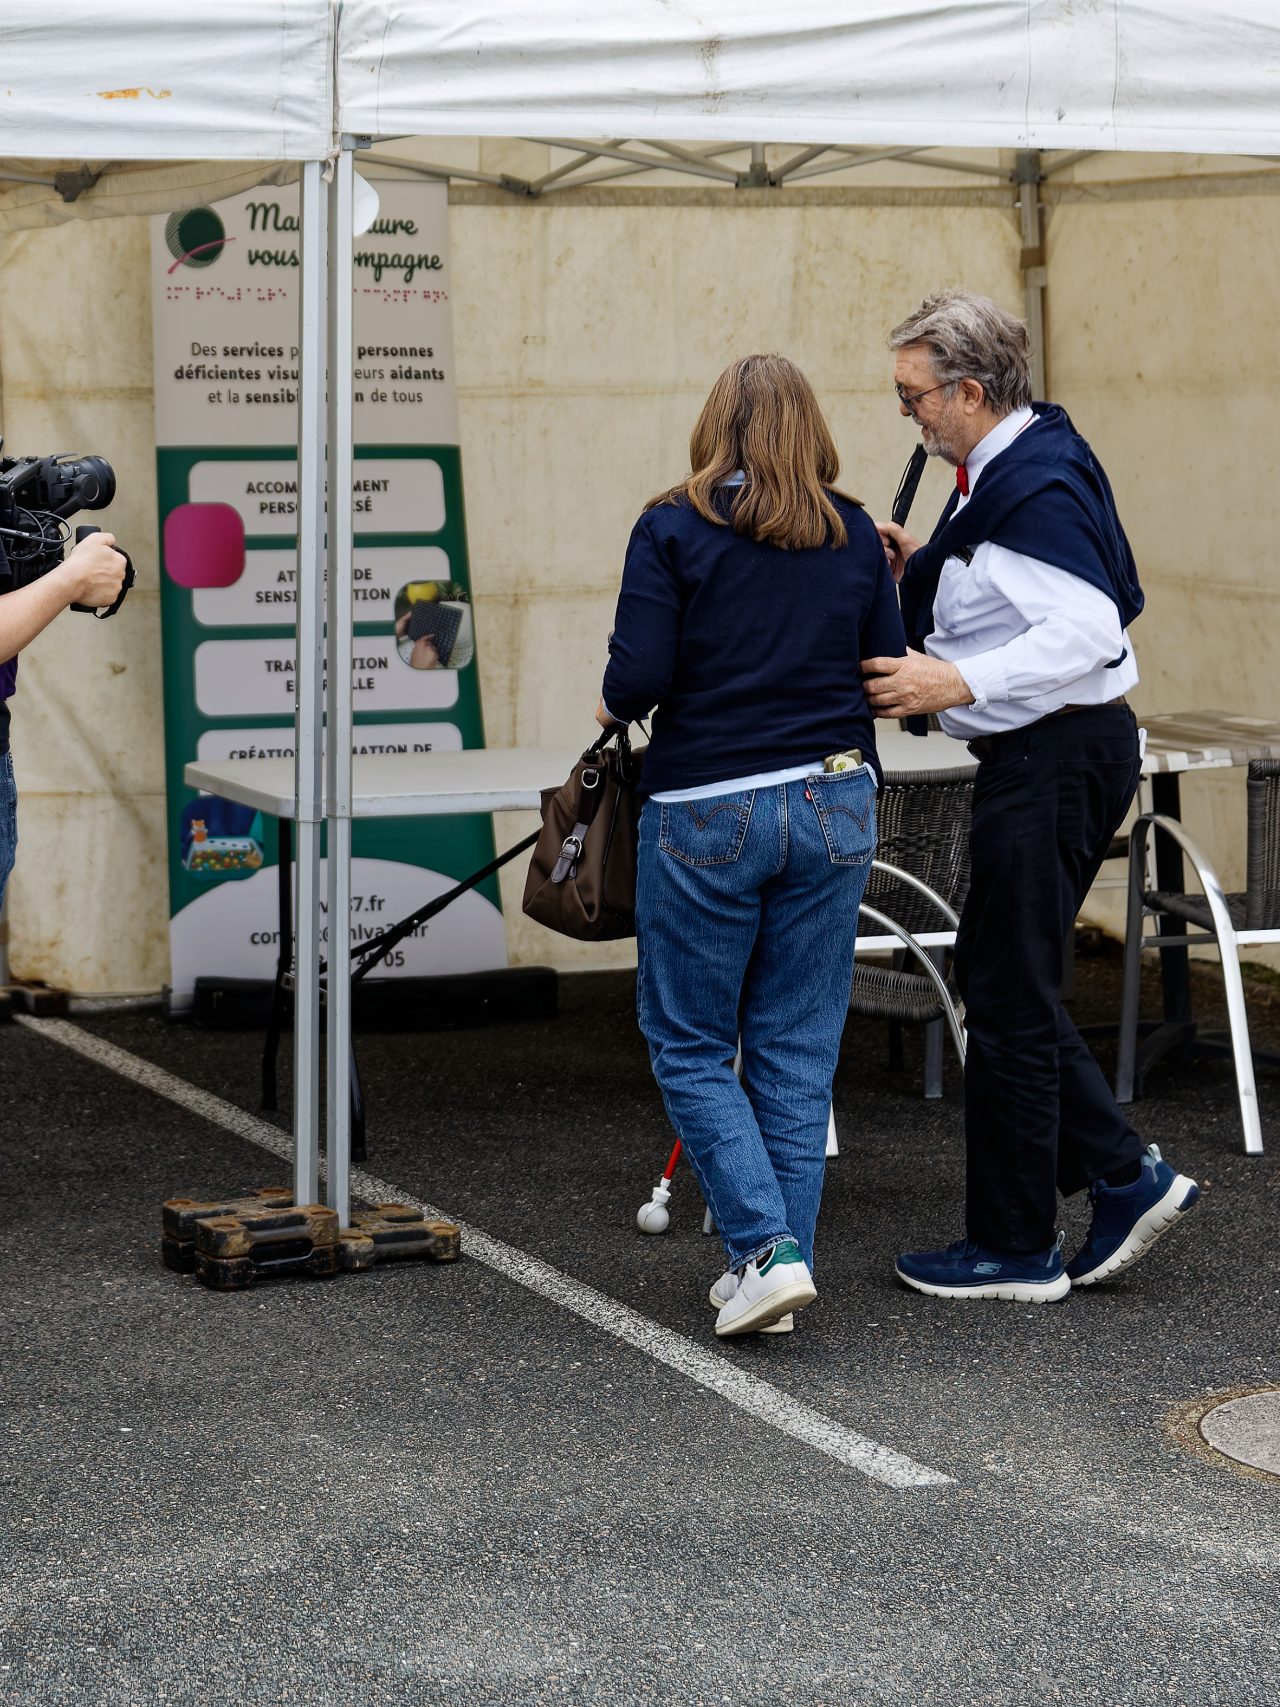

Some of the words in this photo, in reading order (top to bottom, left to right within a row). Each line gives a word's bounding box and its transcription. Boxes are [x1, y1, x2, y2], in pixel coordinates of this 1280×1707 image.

[248, 248, 299, 266] vous
[326, 251, 443, 283] mpagne
[191, 342, 217, 357] Des
[223, 343, 284, 357] services
[357, 345, 434, 361] personnes
[174, 364, 261, 381] déficientes
[354, 367, 385, 380] eurs
[390, 365, 445, 381] aidants
[208, 388, 223, 403] et
[228, 388, 240, 403] la
[371, 387, 388, 402] de
[393, 389, 423, 403] tous
[246, 480, 389, 494] ACCOMMENT
[354, 569, 372, 580] DE
[256, 588, 391, 603] SENSITION
[229, 746, 299, 759] CRÉATIO
[384, 951, 405, 967] 05
